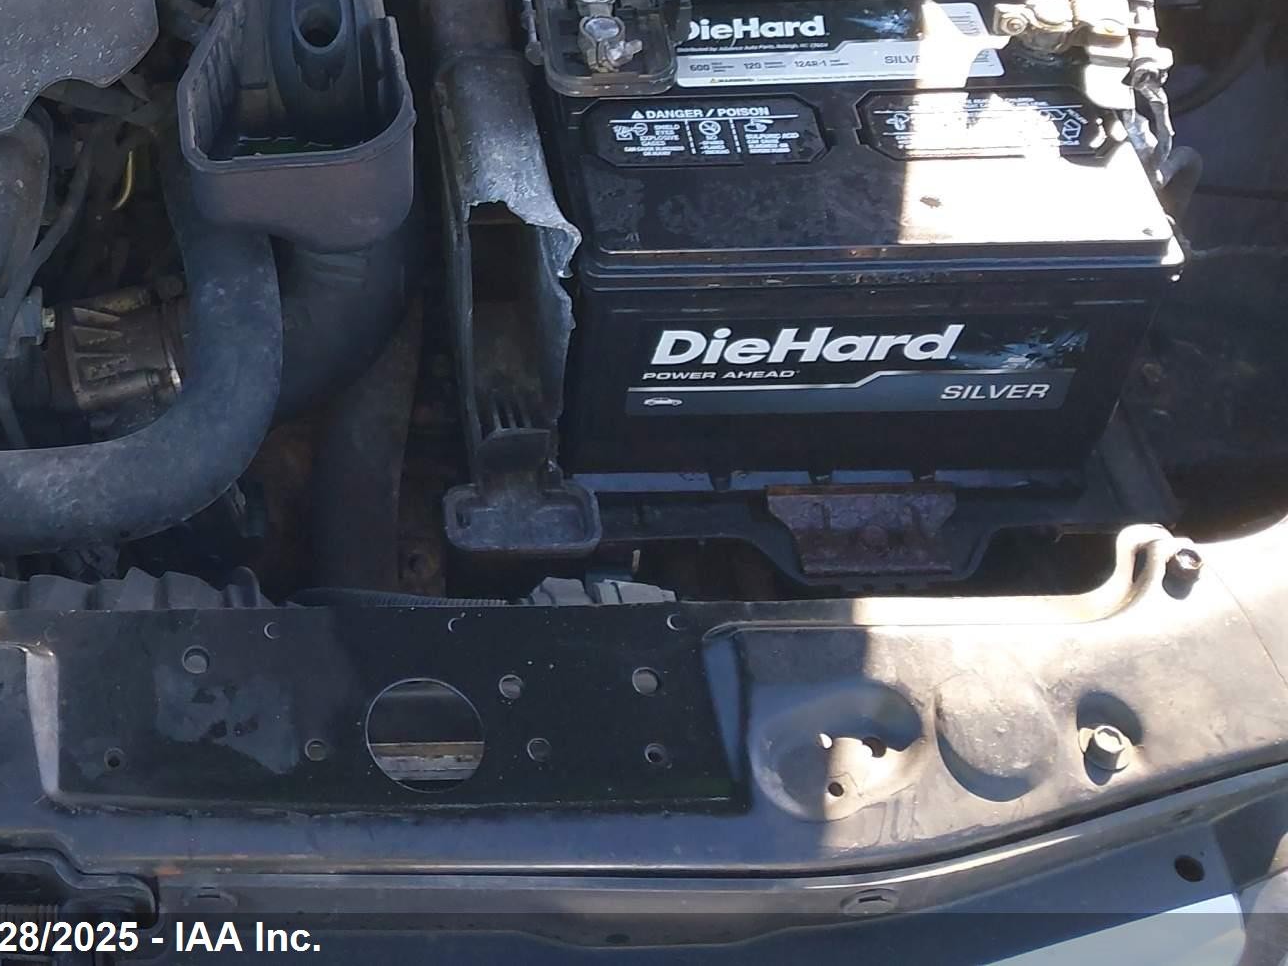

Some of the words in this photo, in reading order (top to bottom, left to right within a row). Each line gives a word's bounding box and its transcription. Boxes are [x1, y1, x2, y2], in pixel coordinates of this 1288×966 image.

[645, 109, 703, 119] DANGER
[717, 107, 770, 117] POISON
[651, 324, 965, 365] DieHard
[642, 371, 716, 381] POWER
[722, 369, 795, 380] AHEAD
[941, 384, 1050, 401] SILVER
